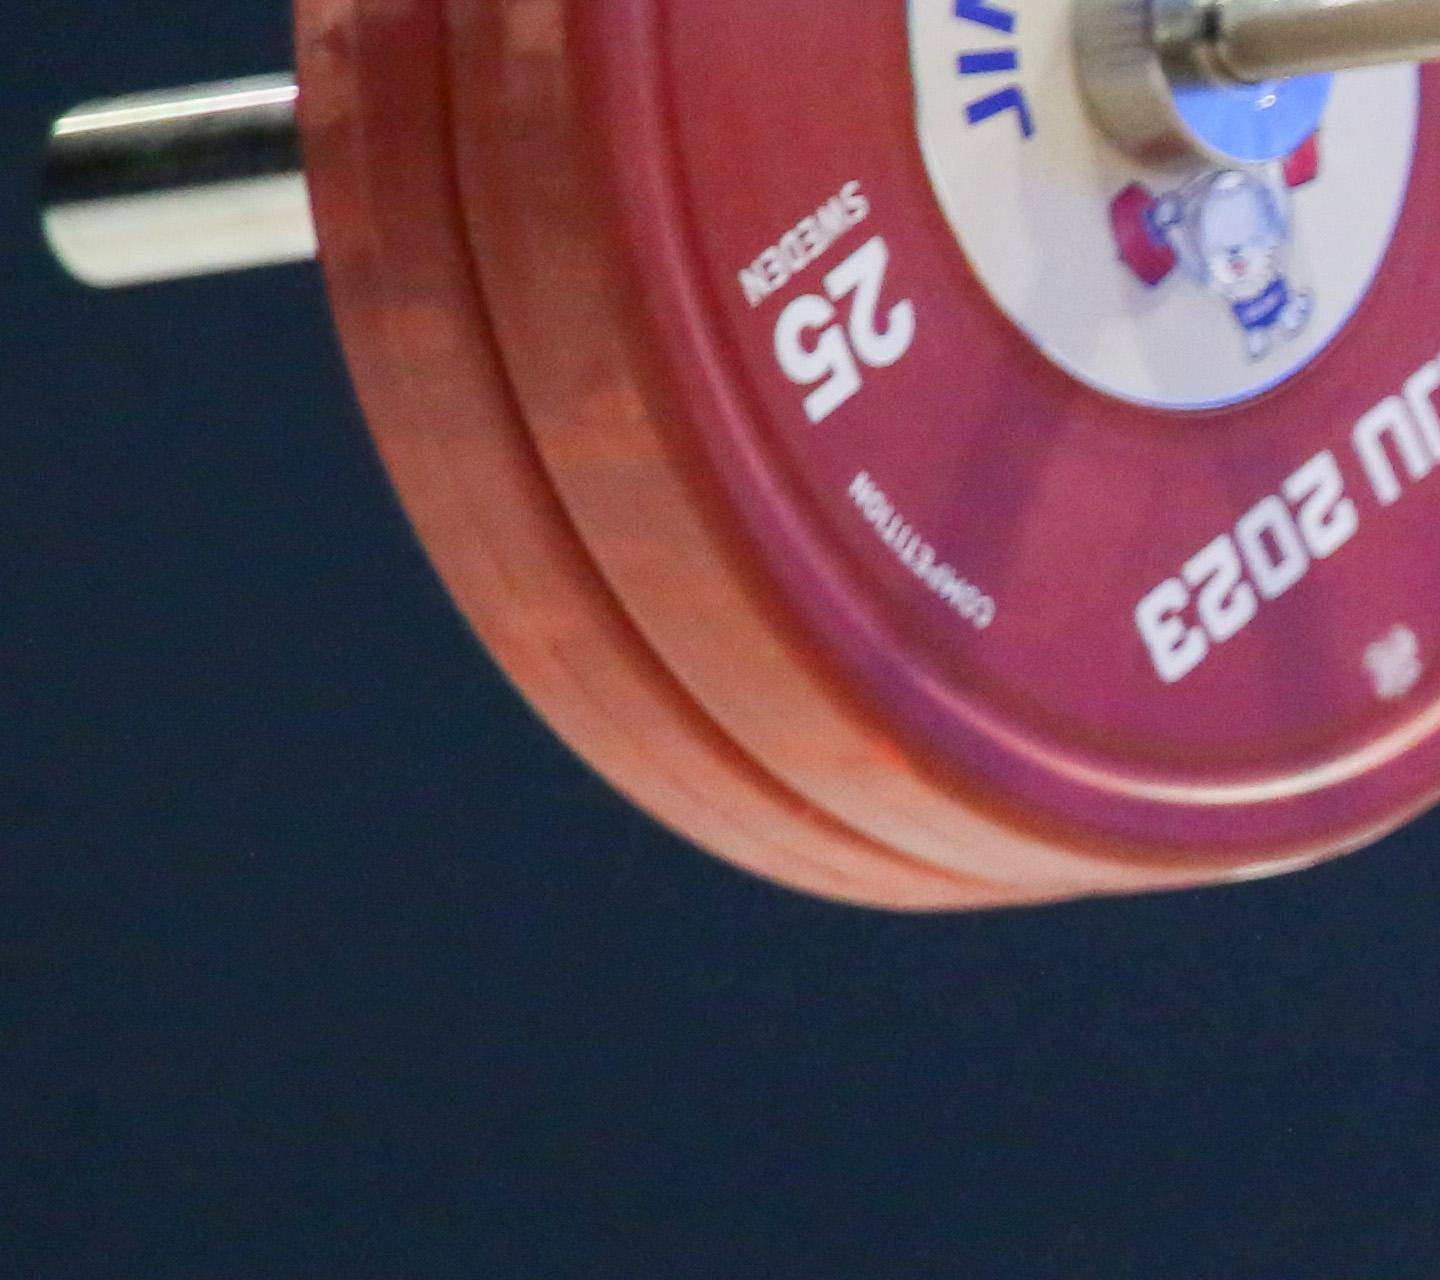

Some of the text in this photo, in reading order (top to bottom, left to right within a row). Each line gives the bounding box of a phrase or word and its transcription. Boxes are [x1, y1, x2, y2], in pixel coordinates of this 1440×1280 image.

[737, 179, 871, 309] SWEDEN
[774, 234, 917, 424] 25
[848, 470, 997, 630] COMPETITION
[1133, 450, 1360, 685] 2023
